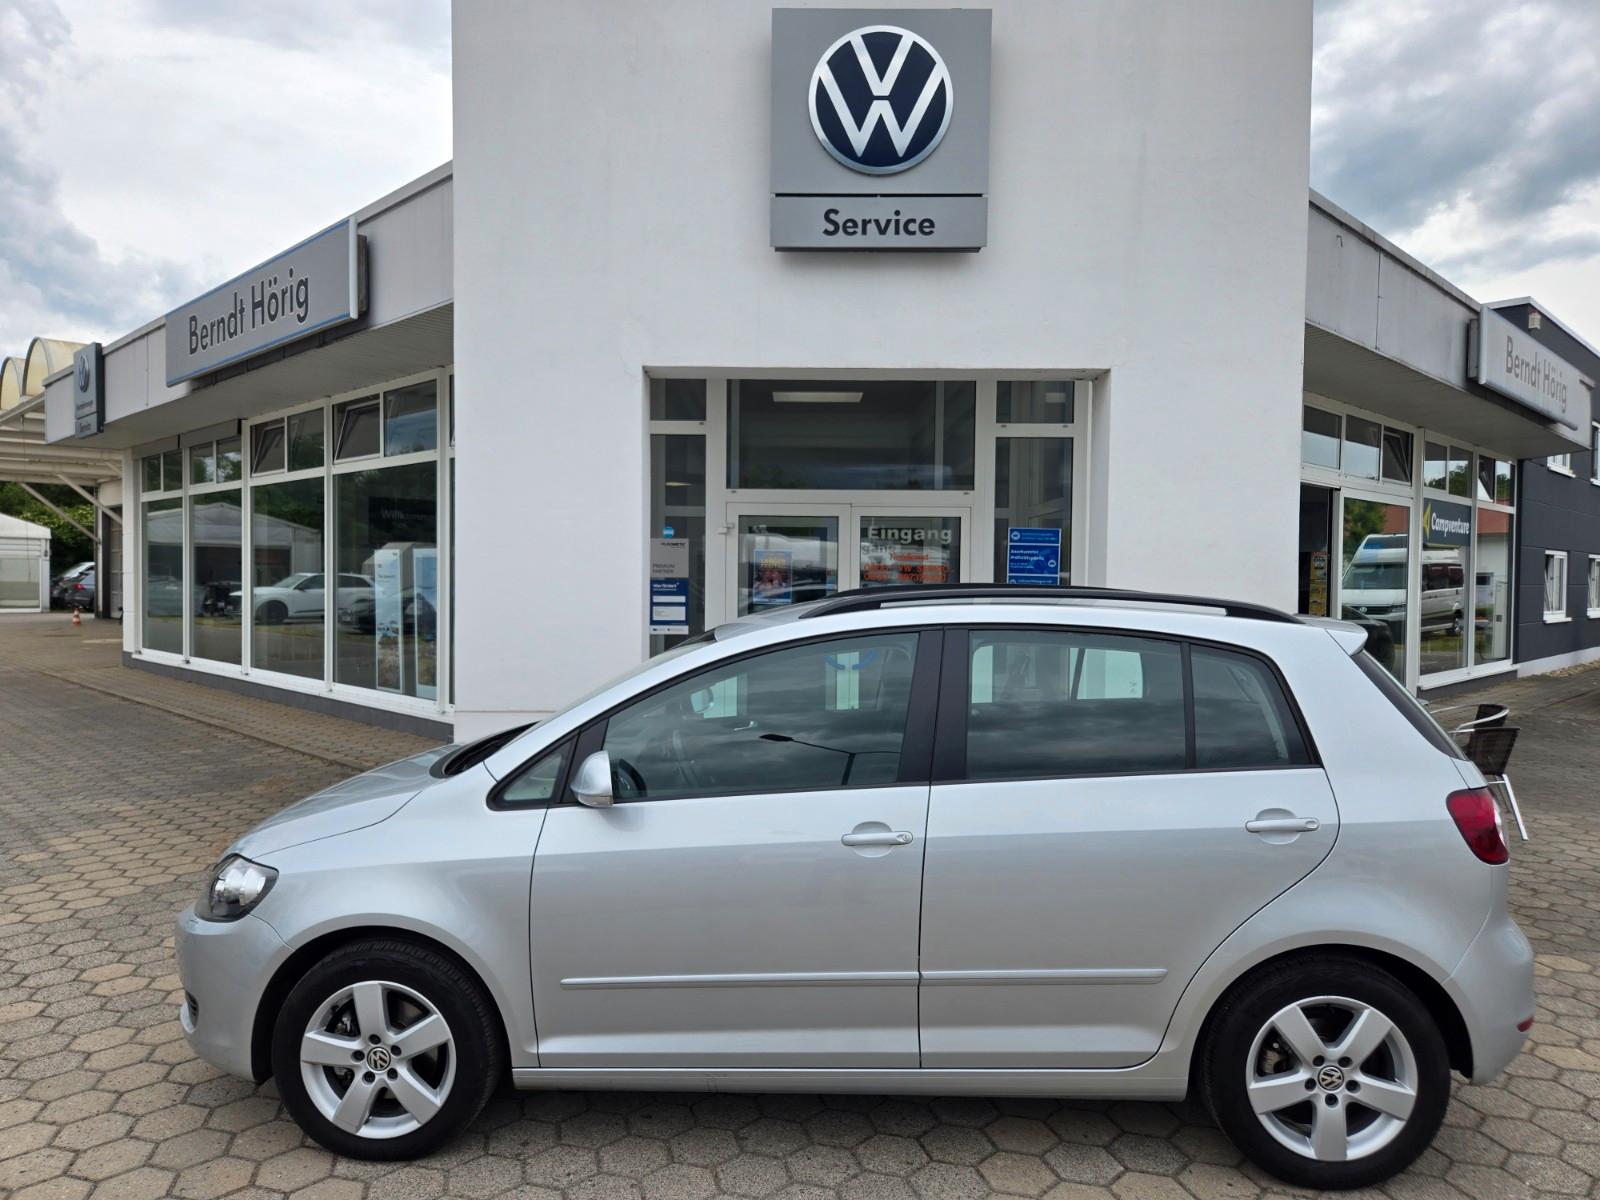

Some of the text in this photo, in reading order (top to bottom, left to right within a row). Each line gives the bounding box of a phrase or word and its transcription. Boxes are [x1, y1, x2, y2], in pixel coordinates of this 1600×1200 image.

[822, 208, 936, 236] Service
[188, 267, 309, 355] Berndt Hörig
[1505, 335, 1567, 414] Berndt Hörig
[867, 526, 952, 544] Eingang
